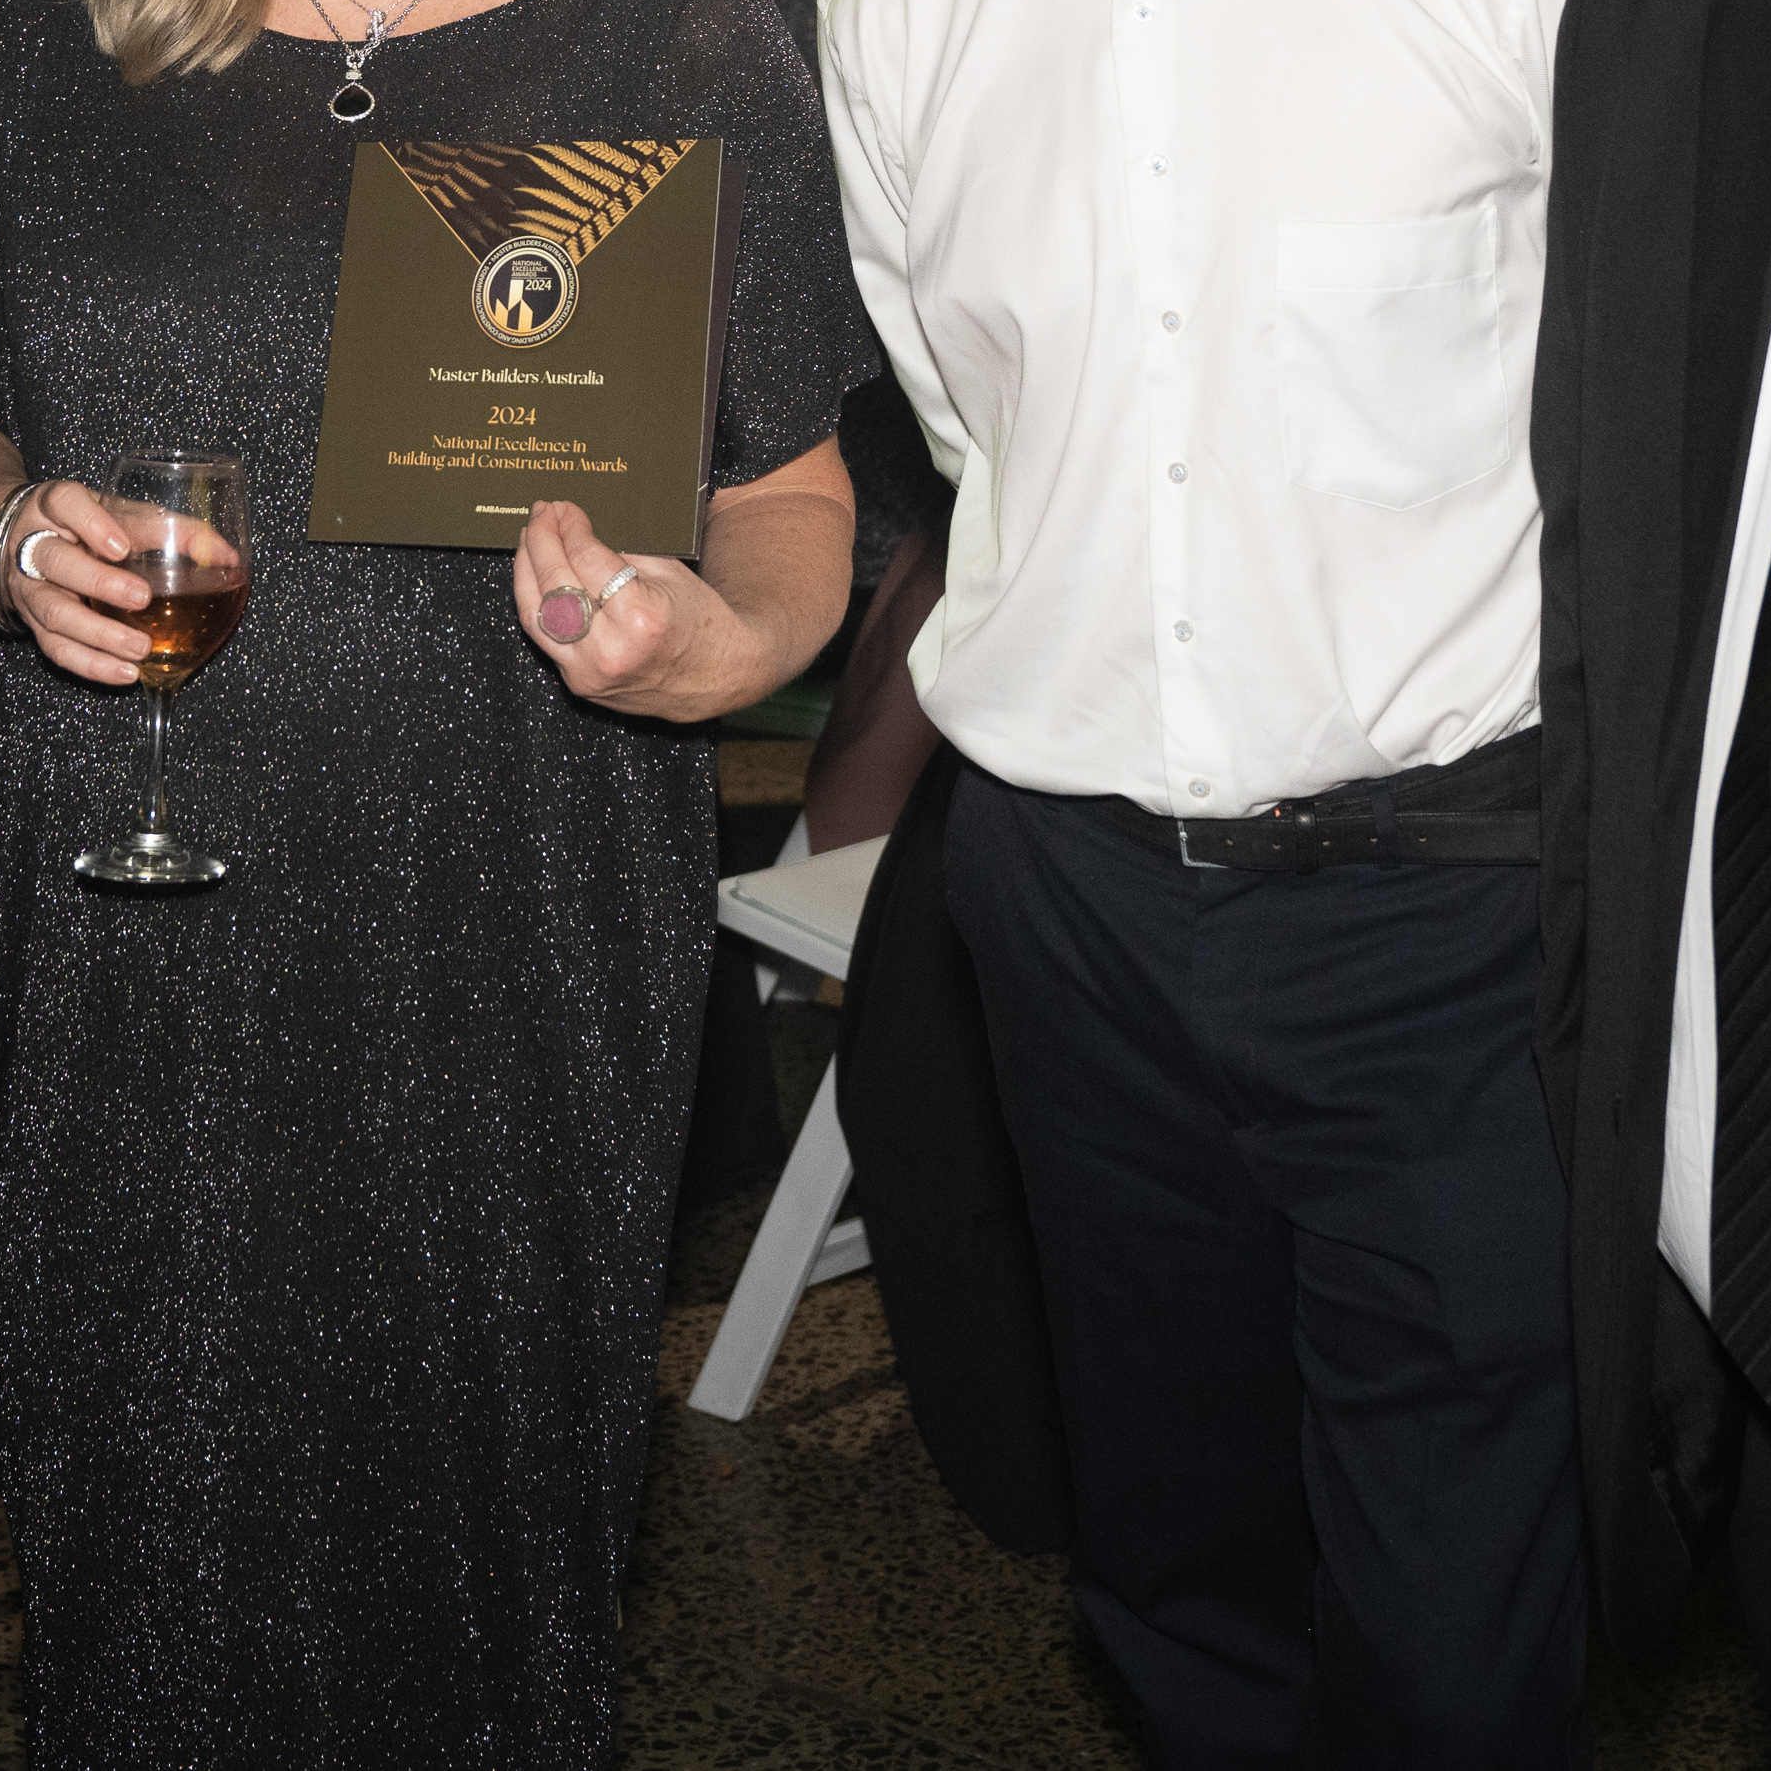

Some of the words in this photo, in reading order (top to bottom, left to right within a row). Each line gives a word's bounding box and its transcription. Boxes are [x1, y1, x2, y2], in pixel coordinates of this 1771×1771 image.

[491, 244, 514, 262] MASTER
[513, 240, 542, 248] BUILDERS
[541, 243, 568, 266] AUSTRALIA
[476, 266, 490, 292] AWARDS
[525, 279, 552, 291] 2024
[566, 268, 575, 300] NATIONAL
[475, 292, 499, 337] CONSTRUCTION
[548, 300, 573, 334] EXCELLENCE
[428, 367, 479, 382] Master
[481, 368, 539, 384] Builders
[540, 370, 604, 385] Australia
[487, 405, 536, 425] 2024
[432, 434, 492, 450] National
[495, 436, 570, 453] Excellence
[573, 439, 587, 453] in
[387, 451, 445, 471] Building
[447, 453, 475, 468] and
[478, 454, 574, 471] Construction
[576, 457, 628, 472] Awards
[475, 505, 529, 515] #MBAawards
